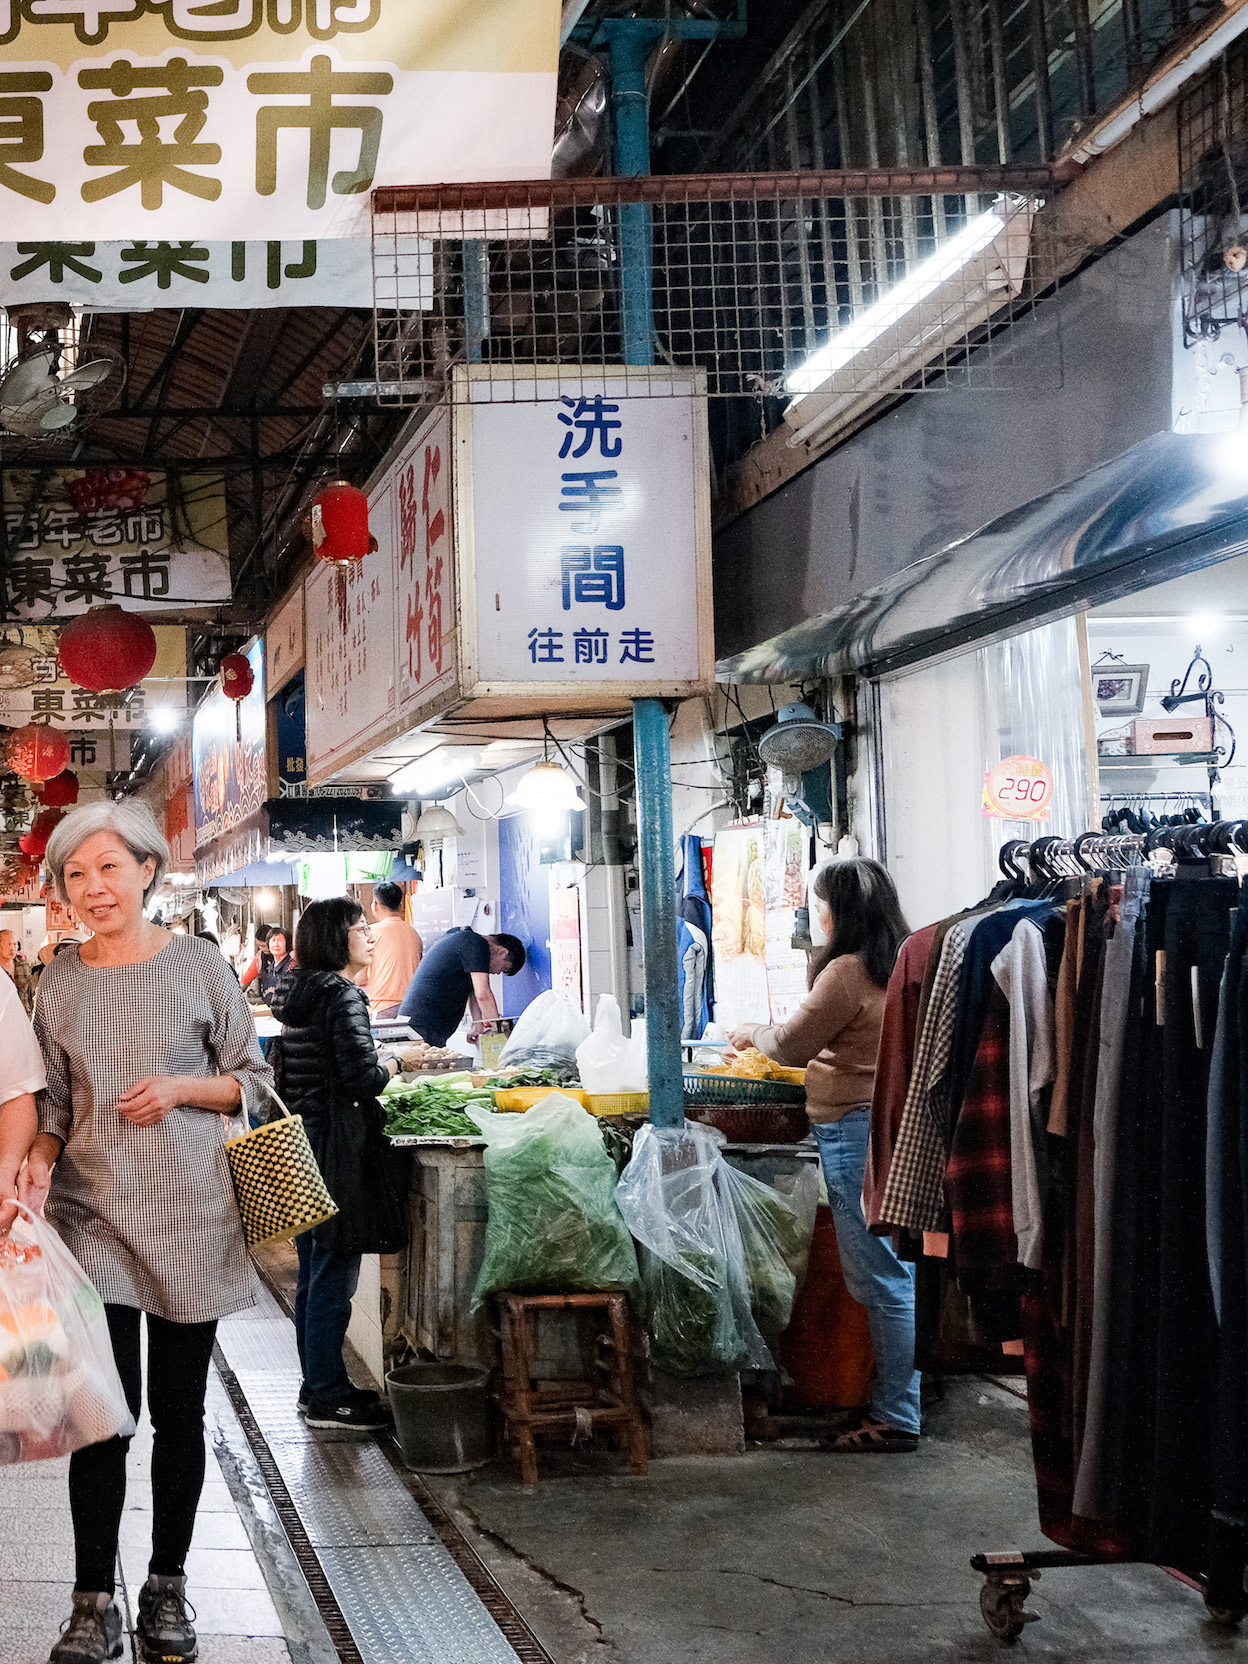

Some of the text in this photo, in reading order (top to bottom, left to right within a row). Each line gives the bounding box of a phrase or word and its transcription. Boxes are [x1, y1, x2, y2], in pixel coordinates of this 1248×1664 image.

[558, 394, 626, 611] 洗手間
[10, 550, 170, 608] 東菜市
[528, 627, 655, 664] 往前走
[31, 688, 145, 723] 東菜市
[998, 778, 1046, 802] 290
